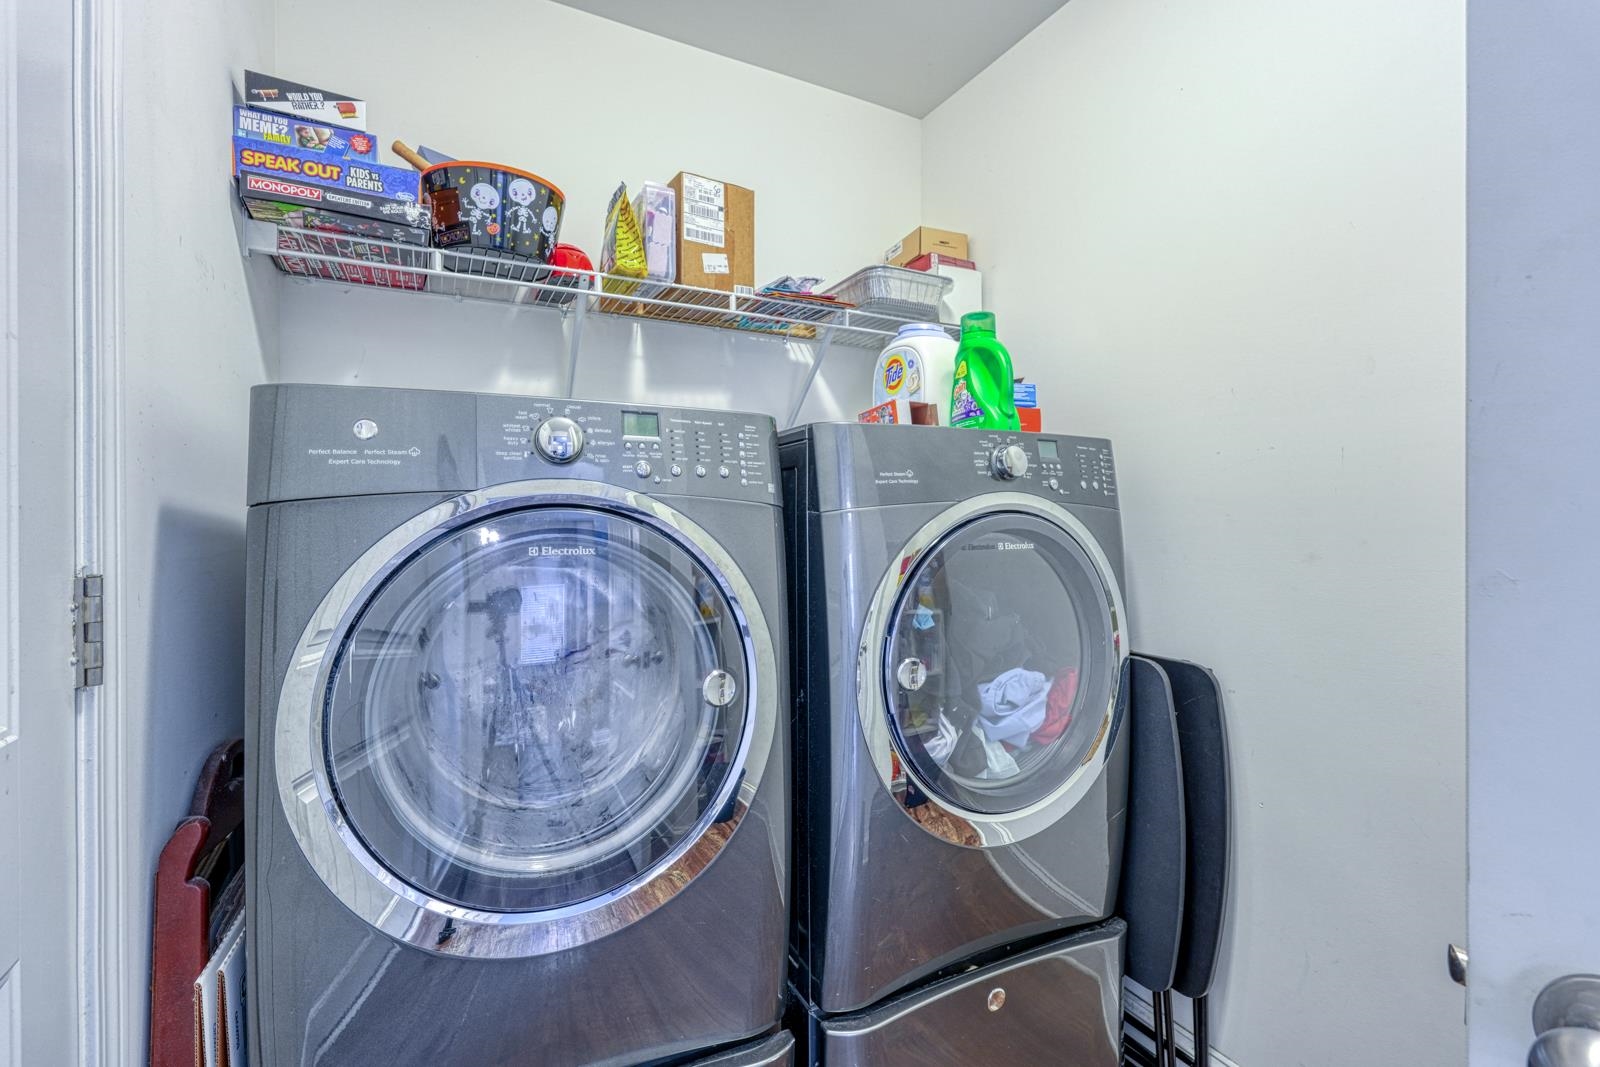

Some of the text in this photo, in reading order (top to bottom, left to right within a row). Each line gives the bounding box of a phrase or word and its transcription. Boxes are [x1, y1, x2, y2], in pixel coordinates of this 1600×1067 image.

[286, 92, 324, 101] WOULD YOU
[239, 108, 288, 124] WHAT DO YOU
[239, 116, 288, 136] MEME?
[263, 131, 291, 144] FAMILY
[241, 151, 343, 181] SPEAK OUT
[350, 166, 371, 180] KIDS
[249, 179, 320, 198] MONOPOLY
[346, 176, 385, 193] PARENTS
[885, 363, 904, 389] Tide
[328, 458, 350, 466] Expert
[366, 458, 401, 466] Technology
[541, 546, 597, 556] Electrolux
[1004, 541, 1035, 550] Electrolux
